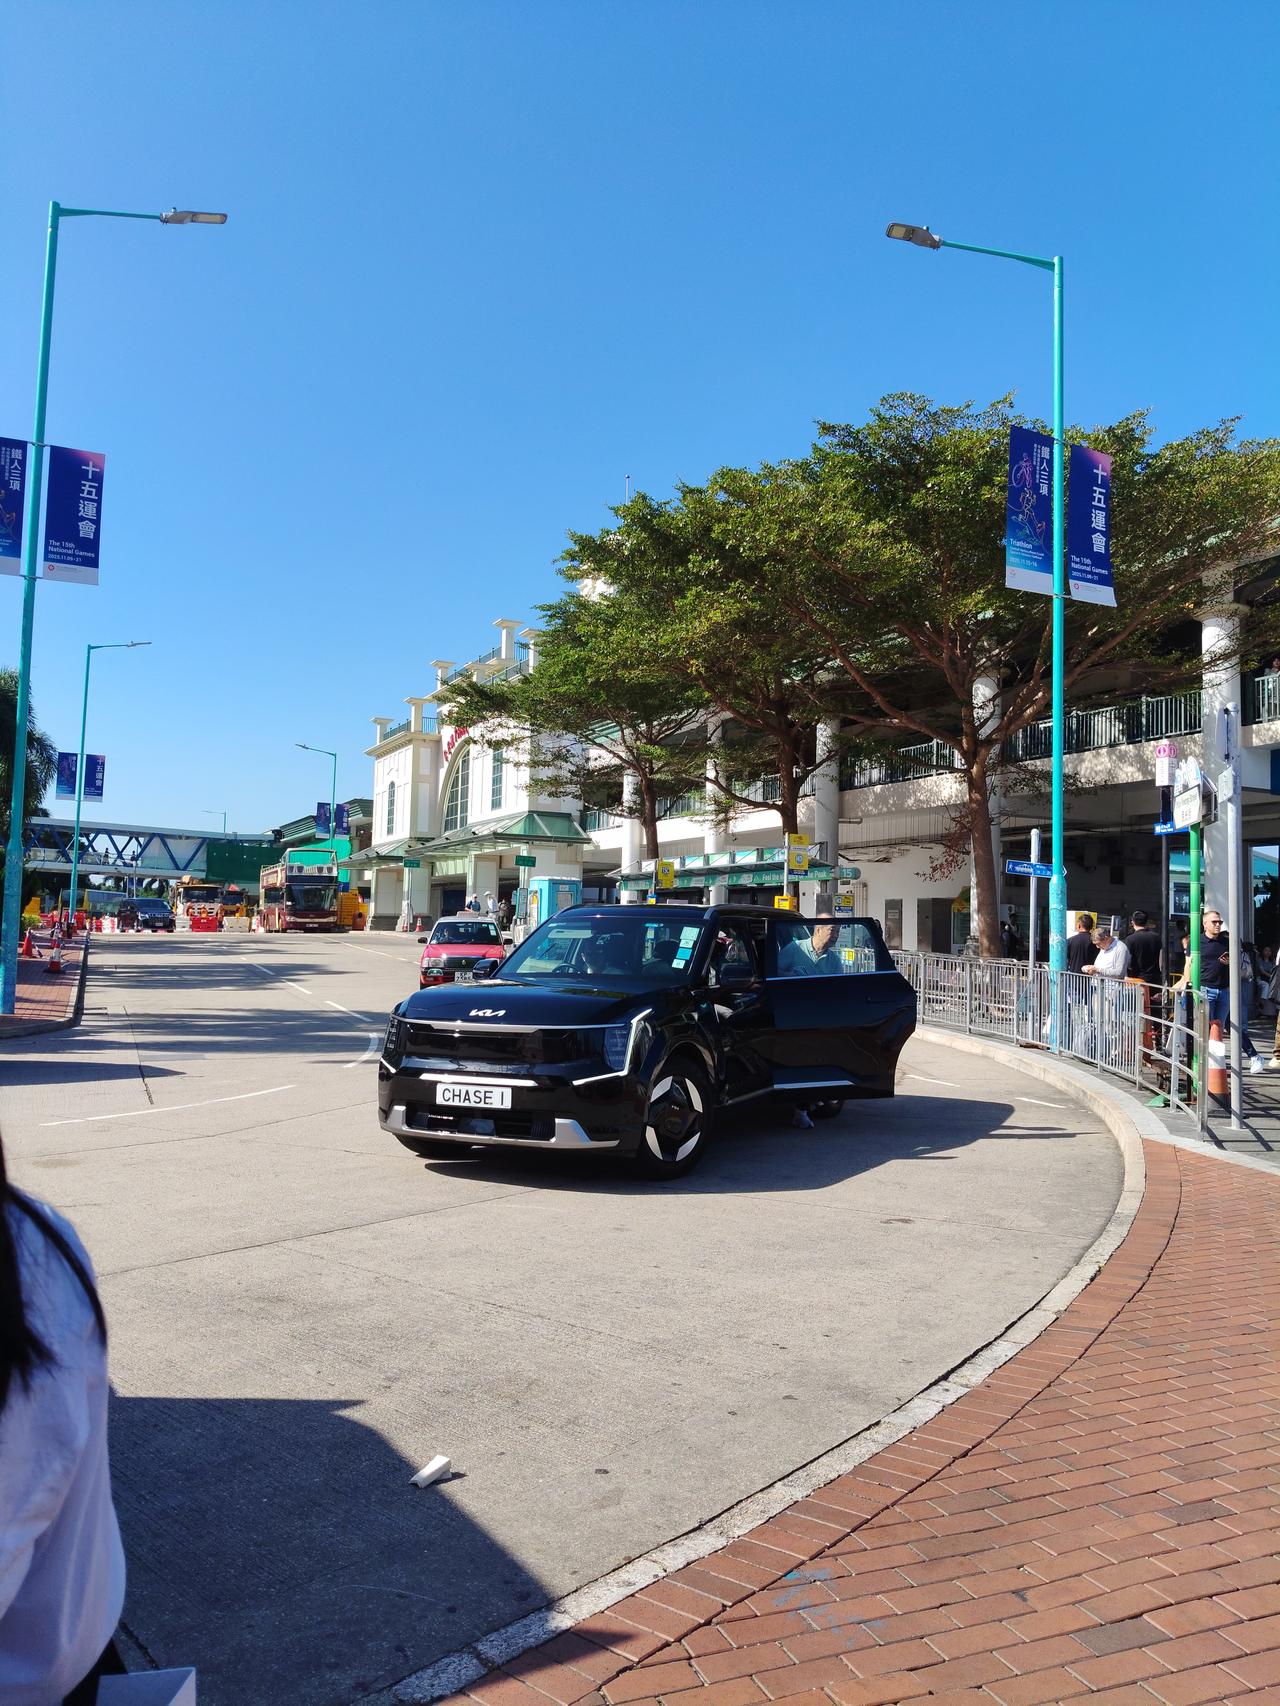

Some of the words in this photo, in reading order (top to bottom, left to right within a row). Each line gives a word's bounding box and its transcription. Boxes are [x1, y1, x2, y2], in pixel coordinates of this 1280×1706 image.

[9, 448, 23, 492] 鐵人三項
[1040, 446, 1050, 497] 鐵人三項
[78, 461, 100, 540] 十五運會
[1091, 464, 1107, 554] 十五運會
[48, 539, 60, 547] The
[62, 541, 76, 549] 15th
[1009, 538, 1033, 550] Triathlon
[48, 546, 74, 555] National
[75, 549, 95, 558] Games
[1070, 554, 1080, 562] The
[1081, 556, 1092, 565] 15th
[1071, 562, 1091, 572] National
[1091, 566, 1109, 575] Games
[814, 870, 827, 878] Peak
[842, 868, 853, 878] 15
[442, 1088, 493, 1105] CHASE
